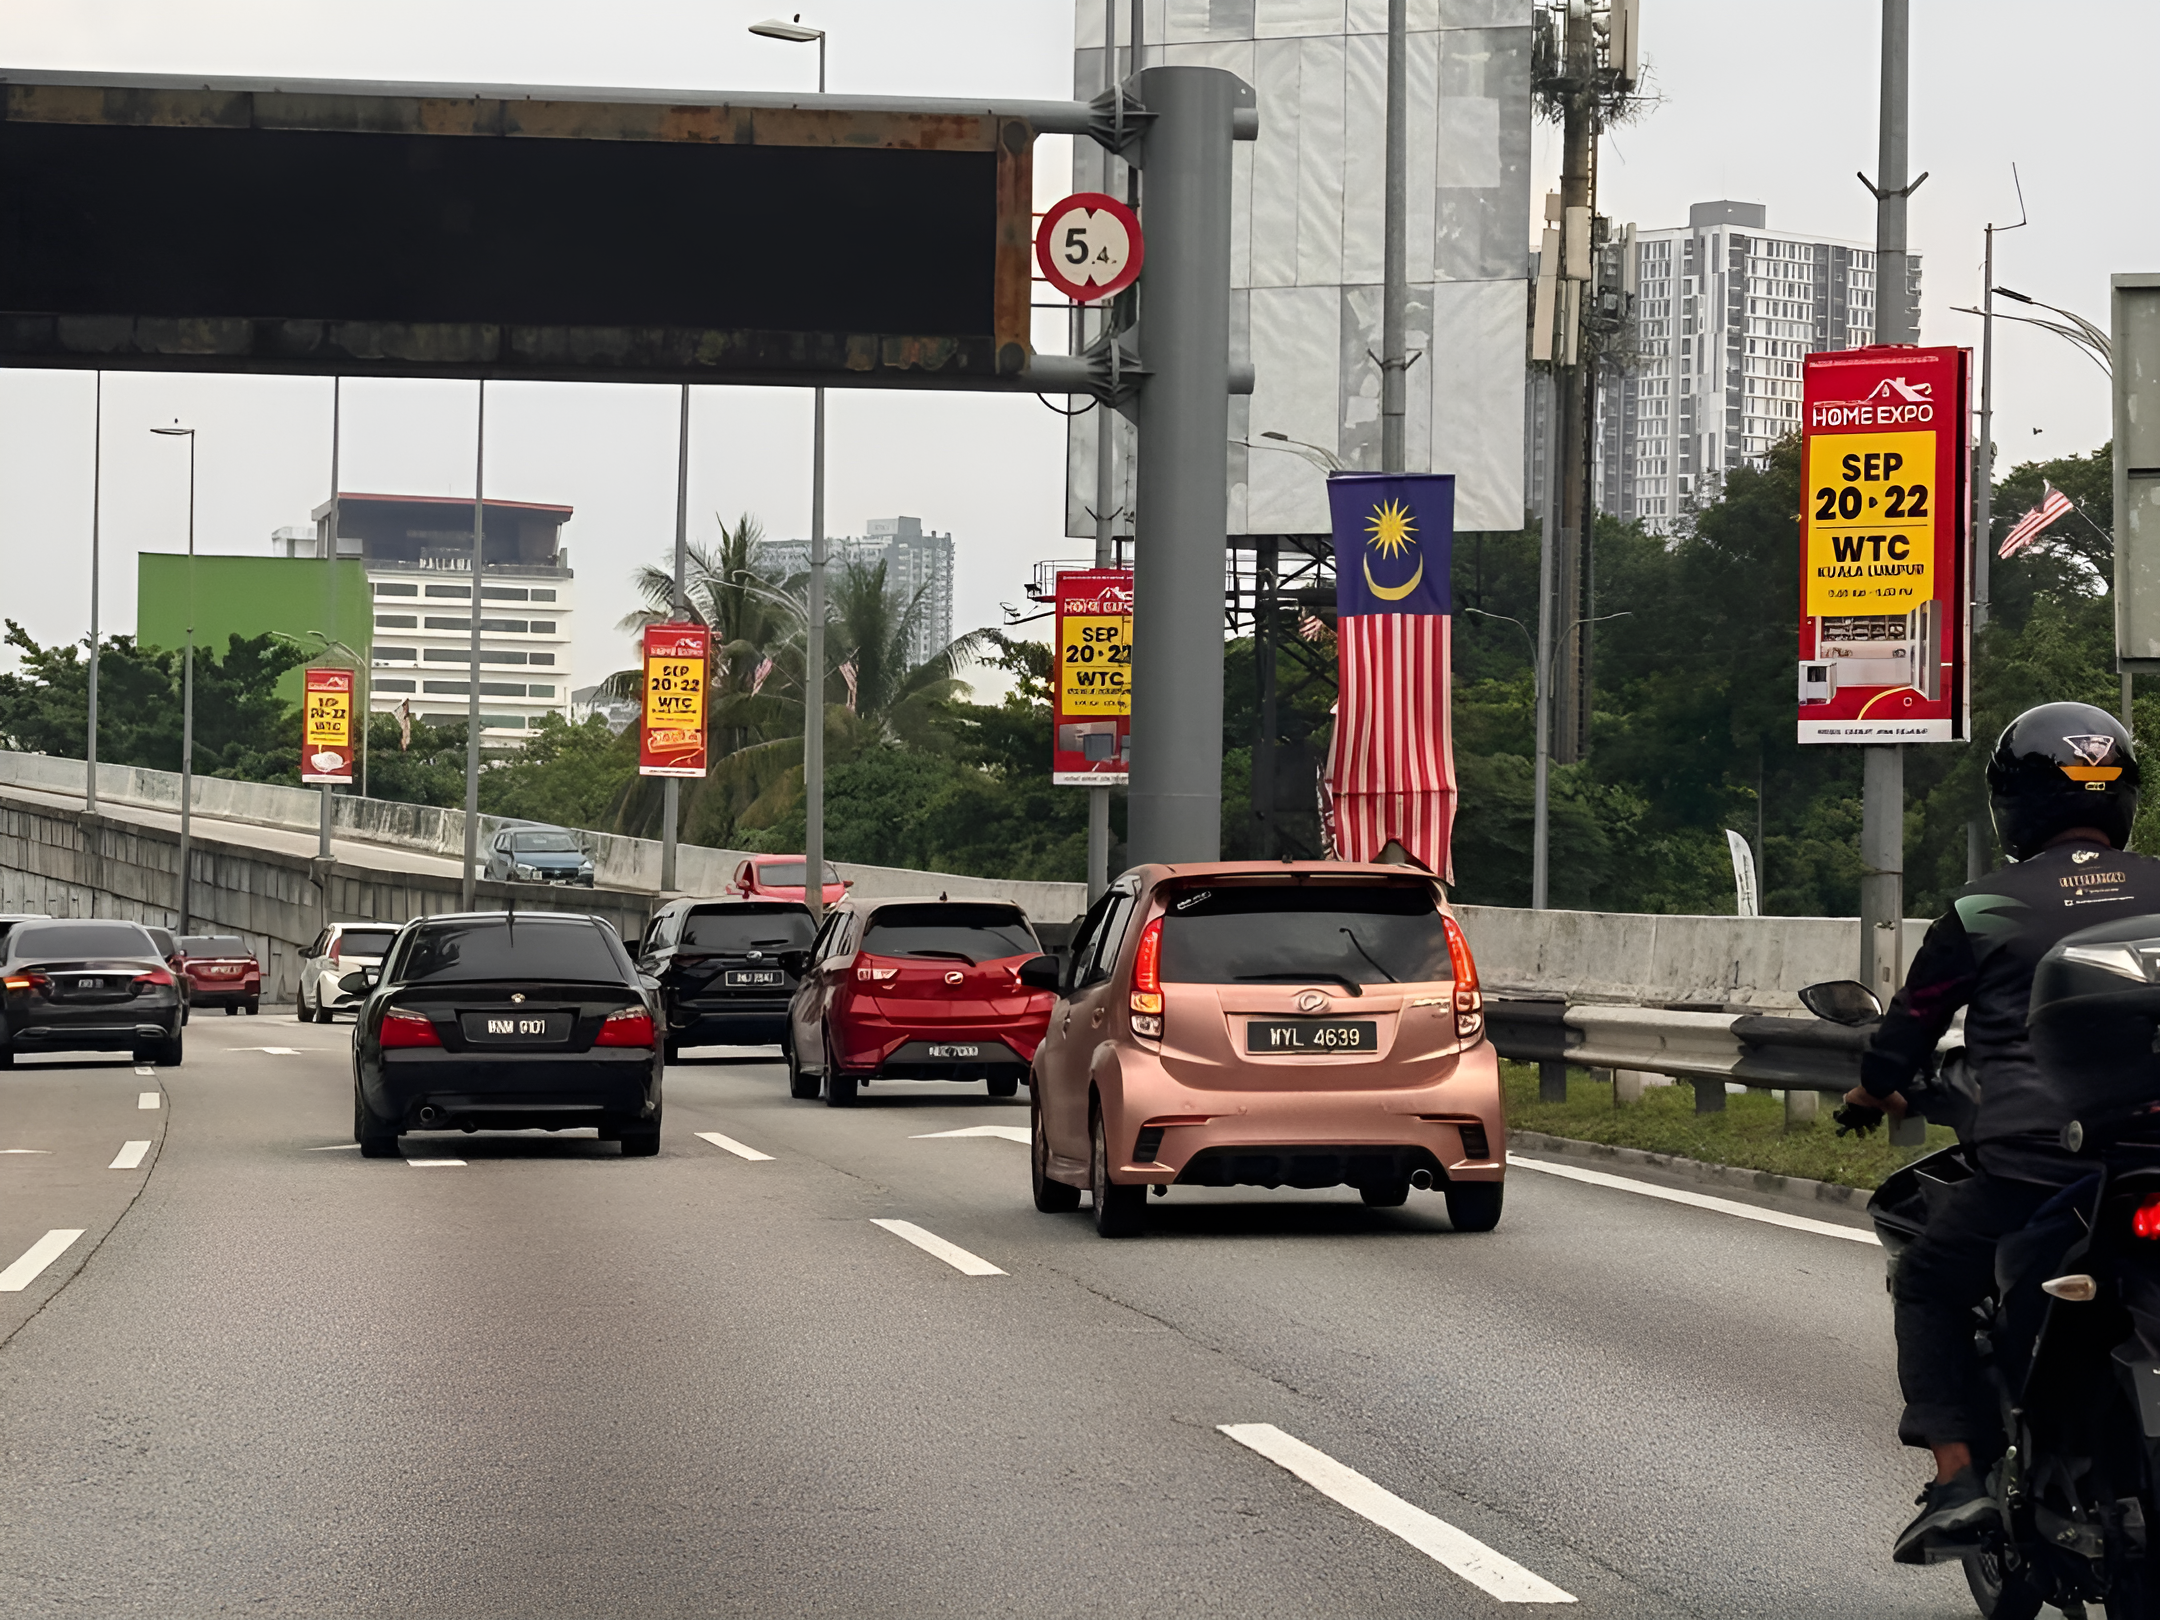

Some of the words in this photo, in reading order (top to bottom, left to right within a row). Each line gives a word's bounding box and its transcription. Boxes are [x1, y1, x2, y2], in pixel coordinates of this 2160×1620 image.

[1812, 406, 1873, 427] HOME
[1877, 404, 1934, 424] EXPO
[1842, 453, 1903, 482] SEP
[1832, 534, 1910, 562] WTC
[1082, 626, 1119, 643] SEP
[1076, 671, 1124, 687] WTC
[658, 696, 693, 710] WTC
[1269, 1028, 1305, 1047] WYL
[1313, 1028, 1360, 1047] 4639
